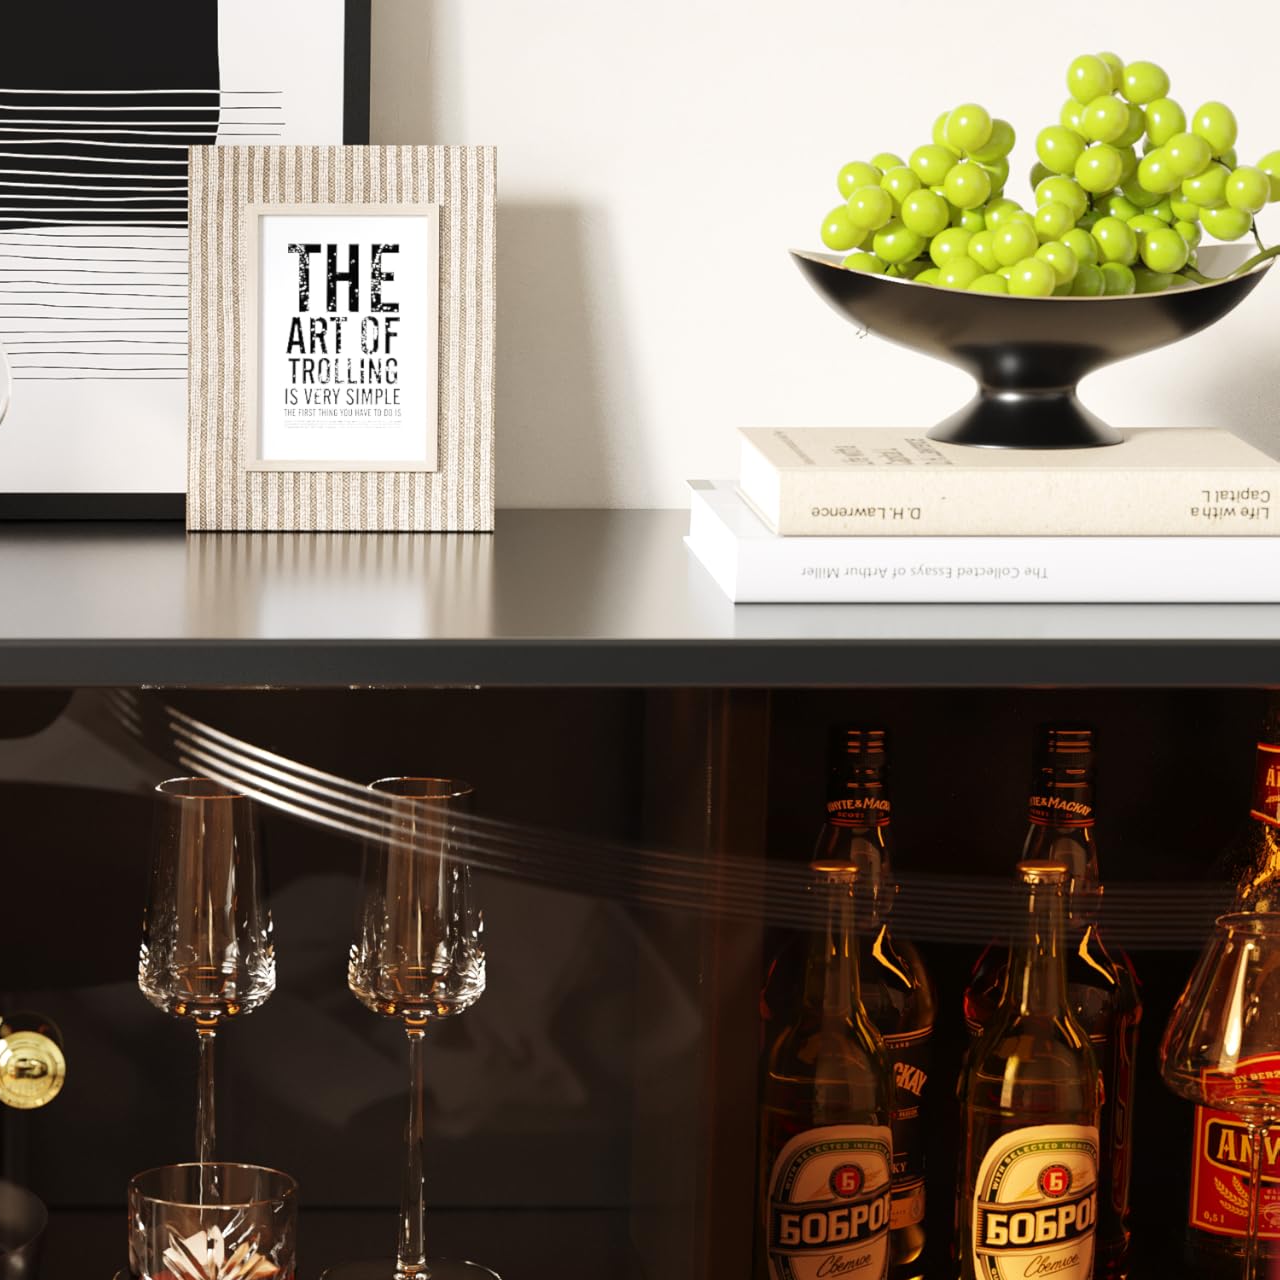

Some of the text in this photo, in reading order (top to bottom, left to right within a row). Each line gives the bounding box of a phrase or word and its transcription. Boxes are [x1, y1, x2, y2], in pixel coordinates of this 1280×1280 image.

[287, 243, 400, 313] THE
[285, 316, 401, 355] ART OF
[287, 357, 399, 385] TROLLING
[284, 387, 401, 406] IS VERY SIMPLE
[283, 408, 402, 417] THE FIRST THING YOU HAVE TO DO IS
[1201, 487, 1271, 503] Capital L
[811, 506, 921, 520] D. H. Lawrence
[1190, 506, 1270, 520] Life with a
[800, 563, 1049, 579] The Collected Essays of Arthur Miller
[992, 1166, 1006, 1191] WITH
[1004, 1143, 1059, 1165] SELECTED
